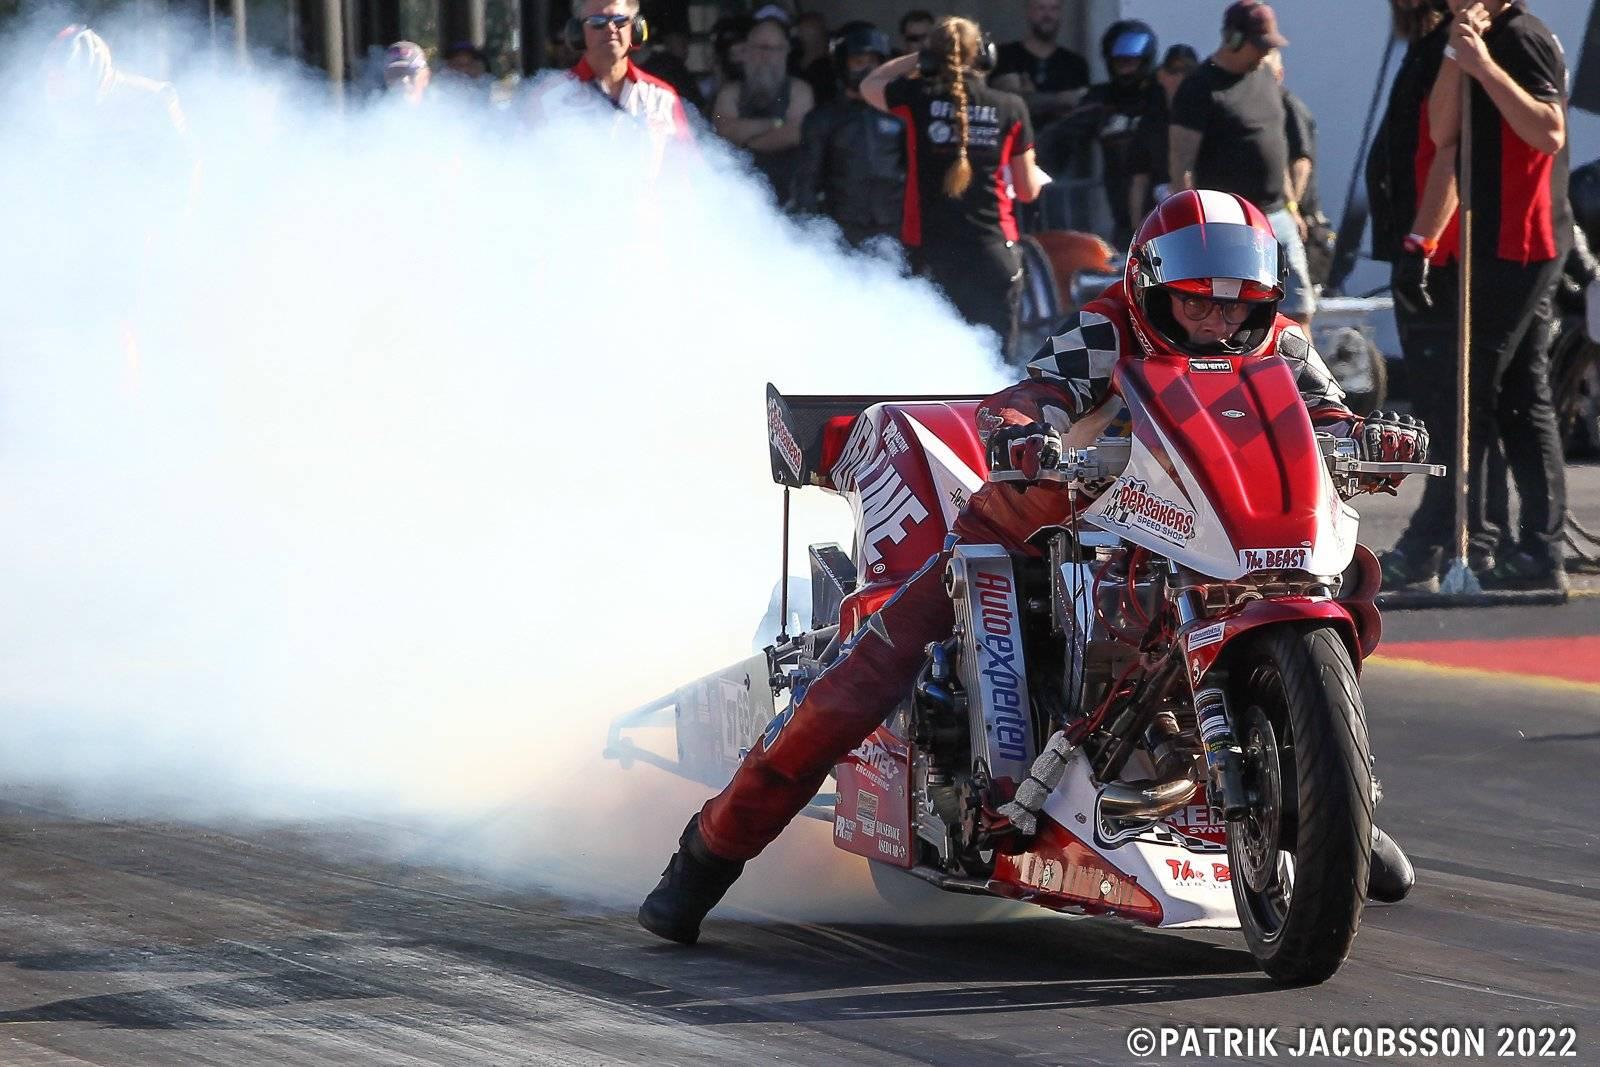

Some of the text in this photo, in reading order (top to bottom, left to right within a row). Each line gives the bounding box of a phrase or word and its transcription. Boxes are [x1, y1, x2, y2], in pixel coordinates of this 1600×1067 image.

[931, 100, 998, 123] OFIAL
[1137, 515, 1184, 542] SPEED SHOP
[1244, 549, 1307, 569] The BEAST
[975, 572, 1028, 761] Autoexperten
[855, 763, 891, 792] ENGINEERING
